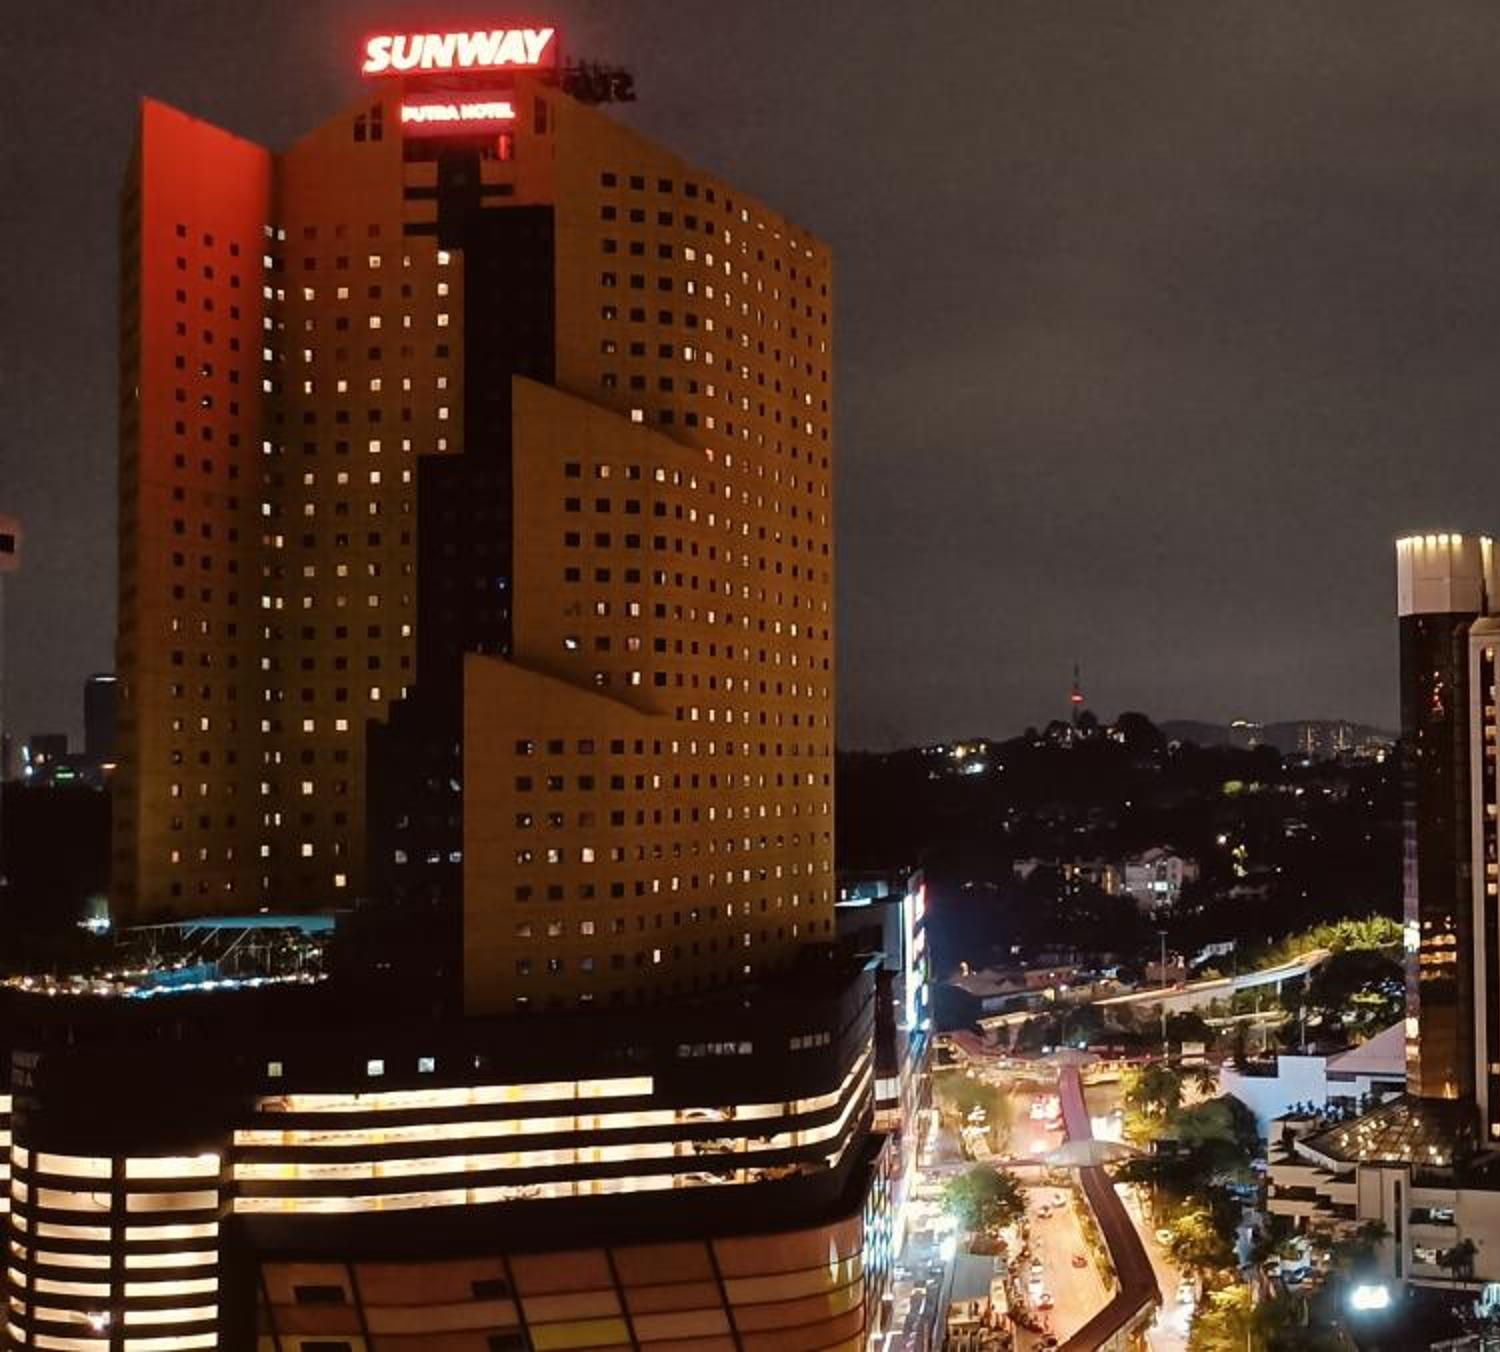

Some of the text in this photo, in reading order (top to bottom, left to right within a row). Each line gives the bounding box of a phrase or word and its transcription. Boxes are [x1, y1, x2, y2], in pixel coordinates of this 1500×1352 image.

[363, 28, 554, 73] SUNWAY
[401, 102, 515, 122] PUTRA HOTEL
